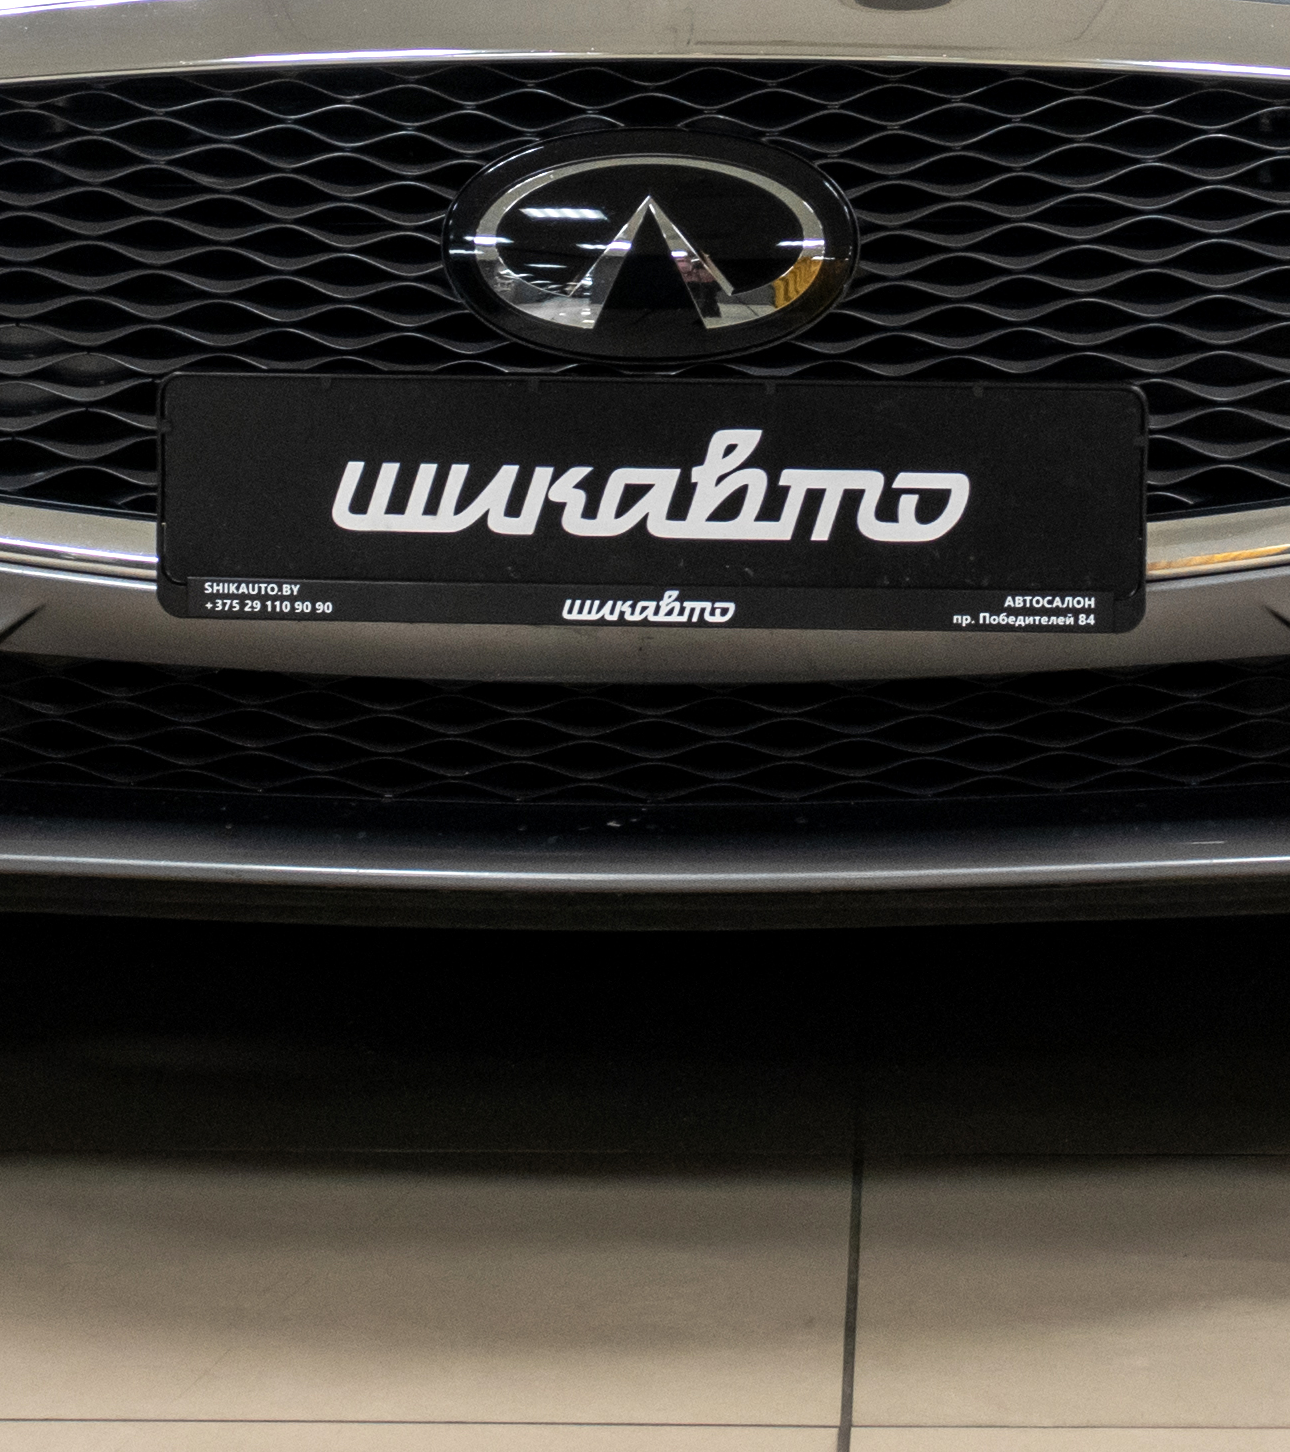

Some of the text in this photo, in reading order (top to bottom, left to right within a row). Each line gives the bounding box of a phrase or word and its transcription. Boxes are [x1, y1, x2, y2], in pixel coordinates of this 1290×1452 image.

[332, 428, 971, 543] шикавто
[204, 582, 300, 595] SHIKAUTO.BY
[205, 599, 332, 613] +375 29 110 90 90
[561, 589, 736, 623] шикавто
[1004, 596, 1095, 608] АВТОСАЛОН
[953, 613, 1095, 627] пр. Победителей 84
